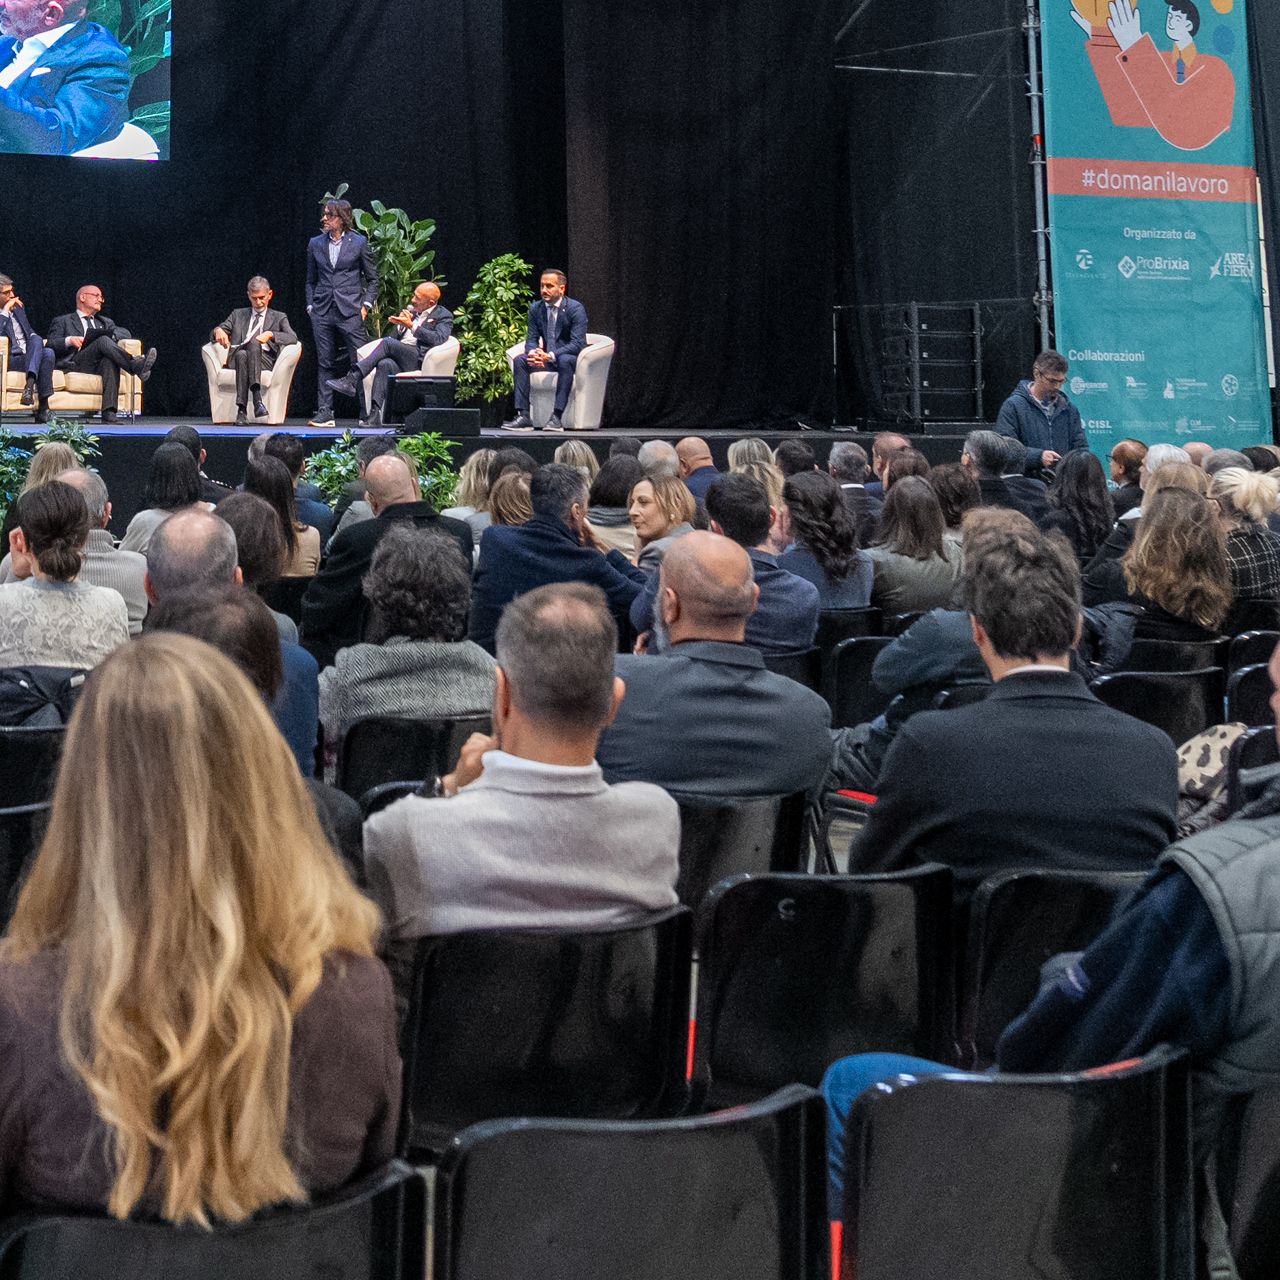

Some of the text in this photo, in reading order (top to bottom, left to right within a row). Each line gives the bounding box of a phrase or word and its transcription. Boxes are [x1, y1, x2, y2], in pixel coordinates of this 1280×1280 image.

[1082, 169, 1229, 194] #domanilavoro
[1124, 227, 1196, 241] Organizzato da
[1136, 255, 1190, 271] ProBrixia
[1068, 349, 1145, 361] Collaborazioni
[1088, 420, 1113, 429] CISL
